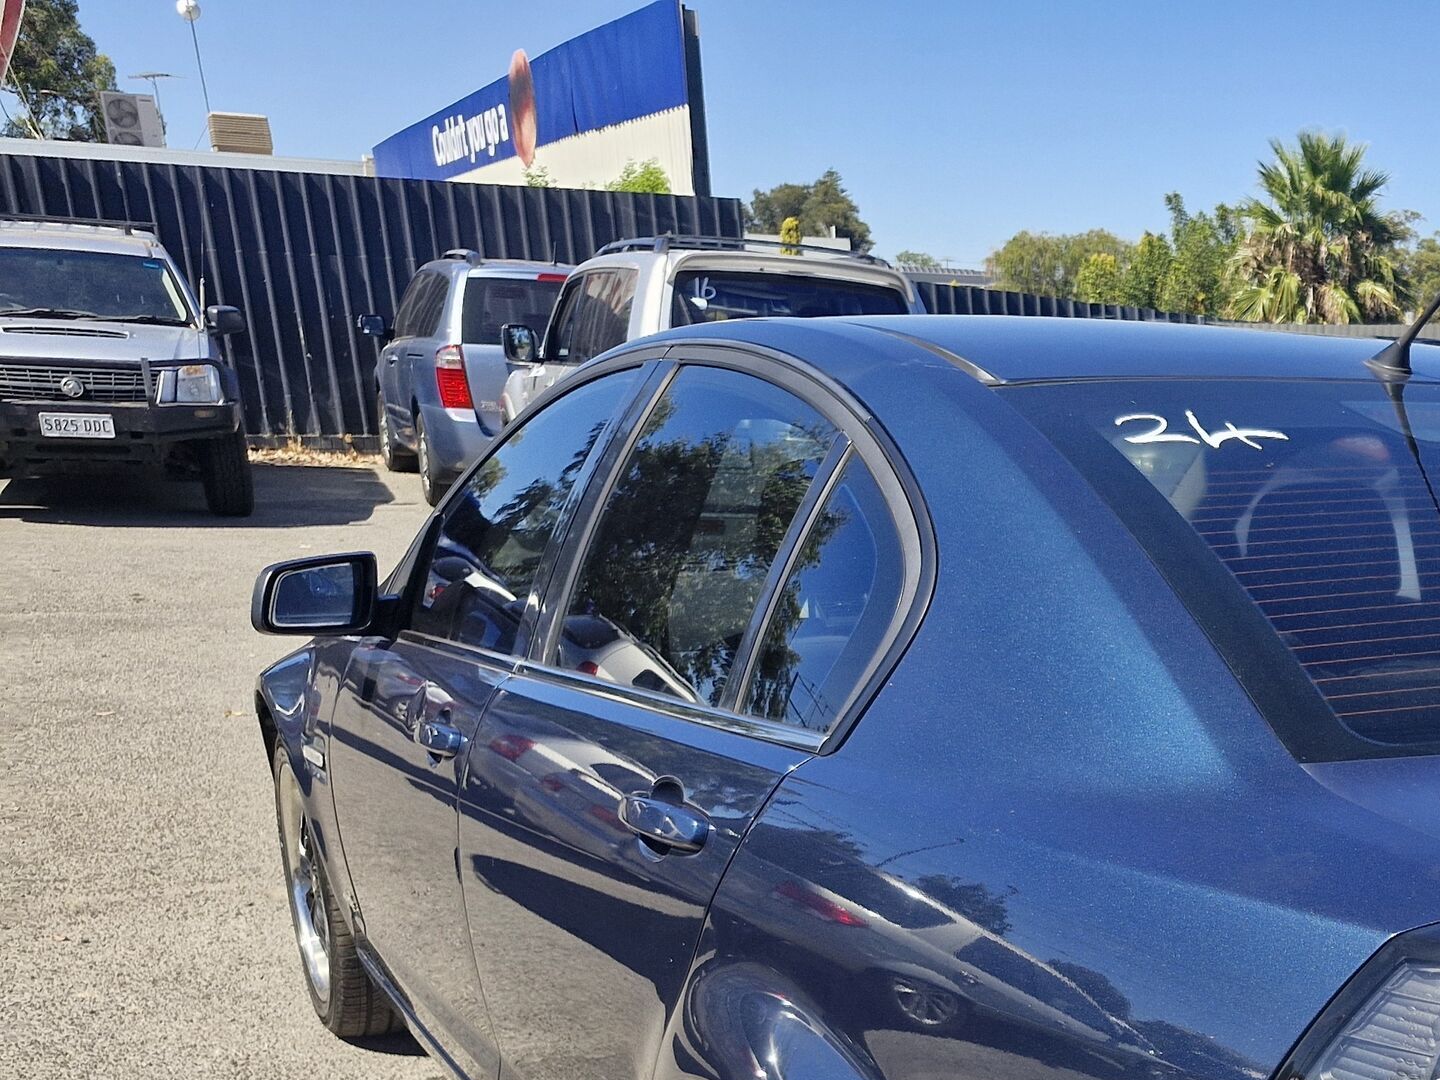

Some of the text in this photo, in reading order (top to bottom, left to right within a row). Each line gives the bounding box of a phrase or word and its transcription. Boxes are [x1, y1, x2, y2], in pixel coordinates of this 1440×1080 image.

[466, 113, 487, 163] you
[484, 107, 500, 157] go
[498, 103, 509, 142] a
[694, 276, 717, 300] 16
[44, 418, 111, 433] S825 DDC
